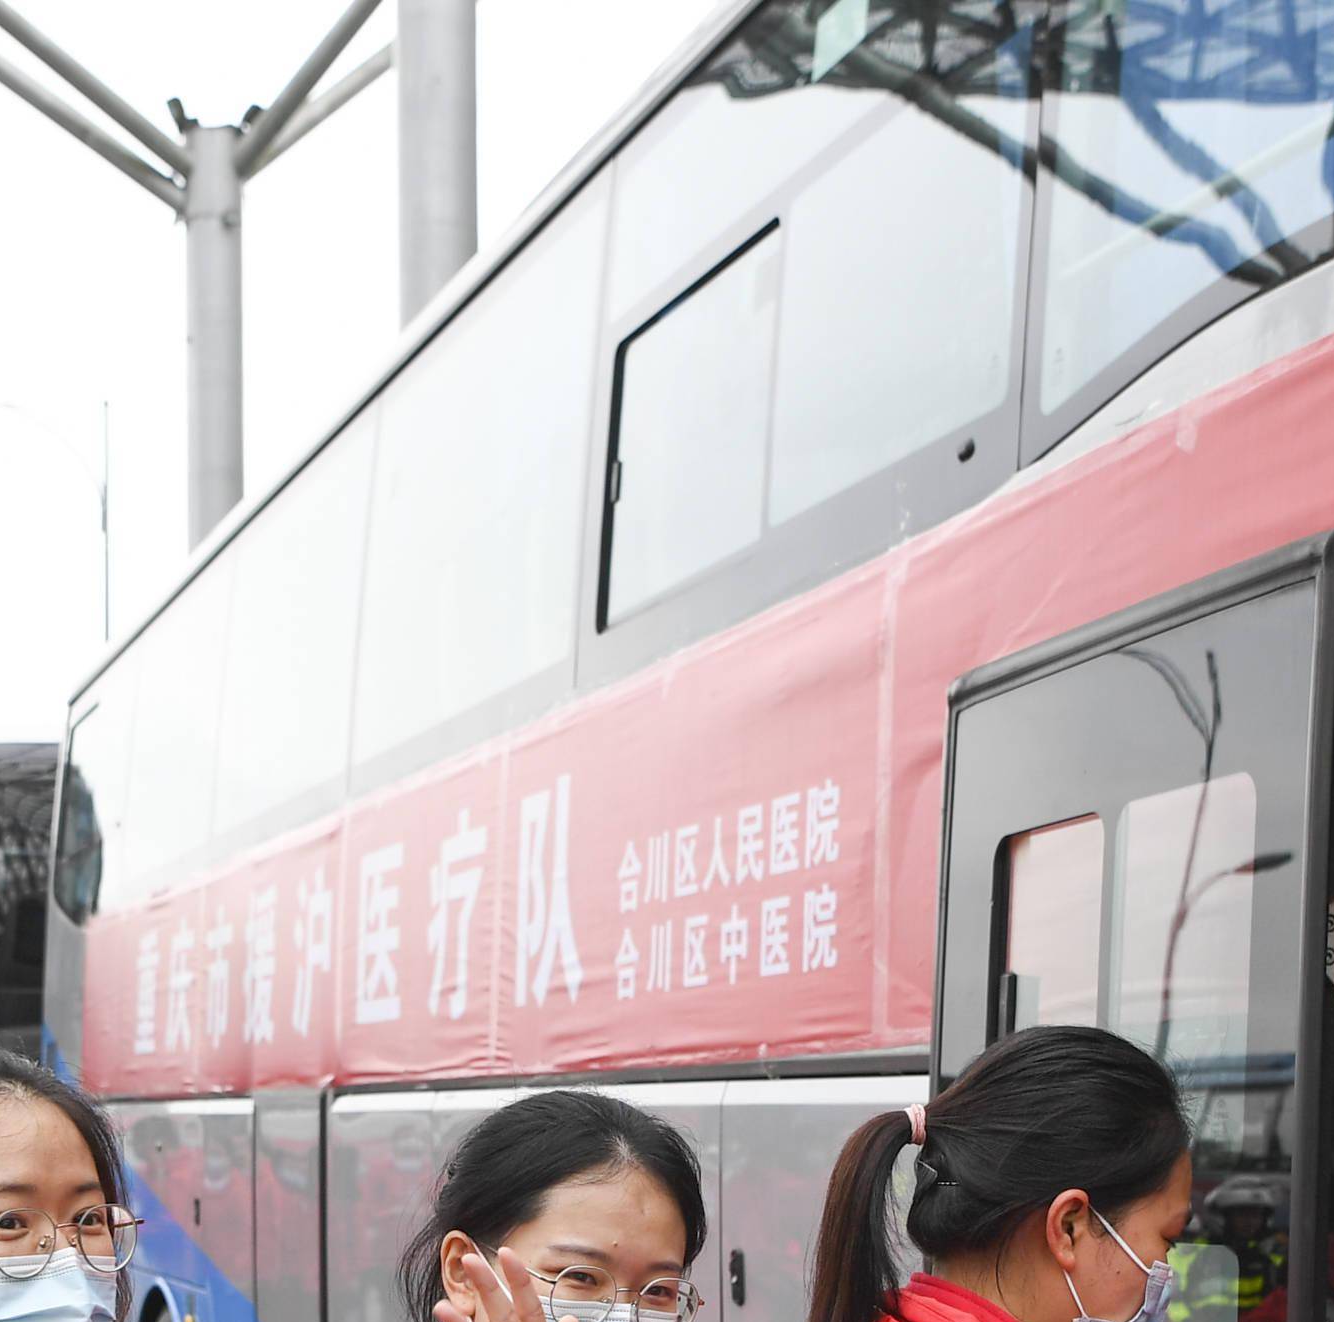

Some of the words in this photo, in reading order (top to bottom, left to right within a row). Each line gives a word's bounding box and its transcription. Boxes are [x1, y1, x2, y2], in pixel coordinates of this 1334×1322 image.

[134, 773, 585, 1055] 重庆市援沪医疗队
[616, 777, 841, 914] 合川区人民医院
[614, 882, 839, 1001] 合川区中医院
